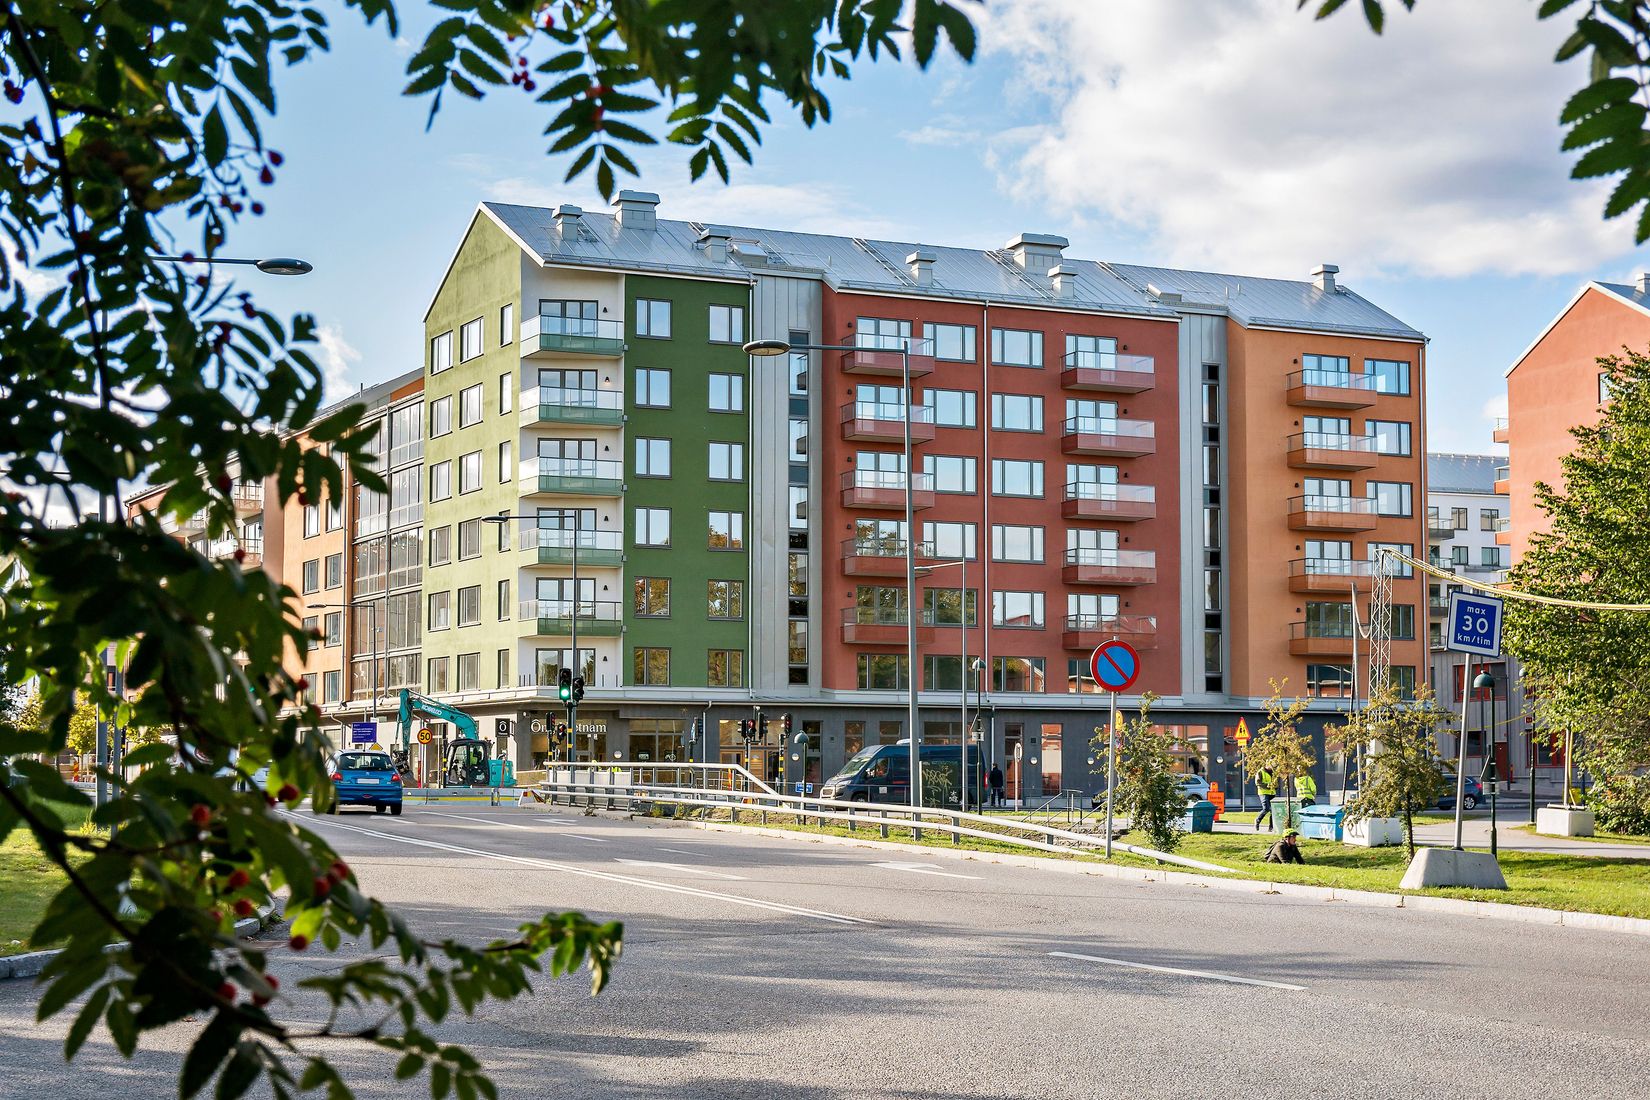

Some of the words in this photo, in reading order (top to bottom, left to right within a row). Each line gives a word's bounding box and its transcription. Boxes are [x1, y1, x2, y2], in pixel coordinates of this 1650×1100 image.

[1467, 605, 1486, 615] max
[1462, 615, 1489, 634] 30
[1457, 633, 1491, 646] km/tim
[420, 732, 430, 741] 50
